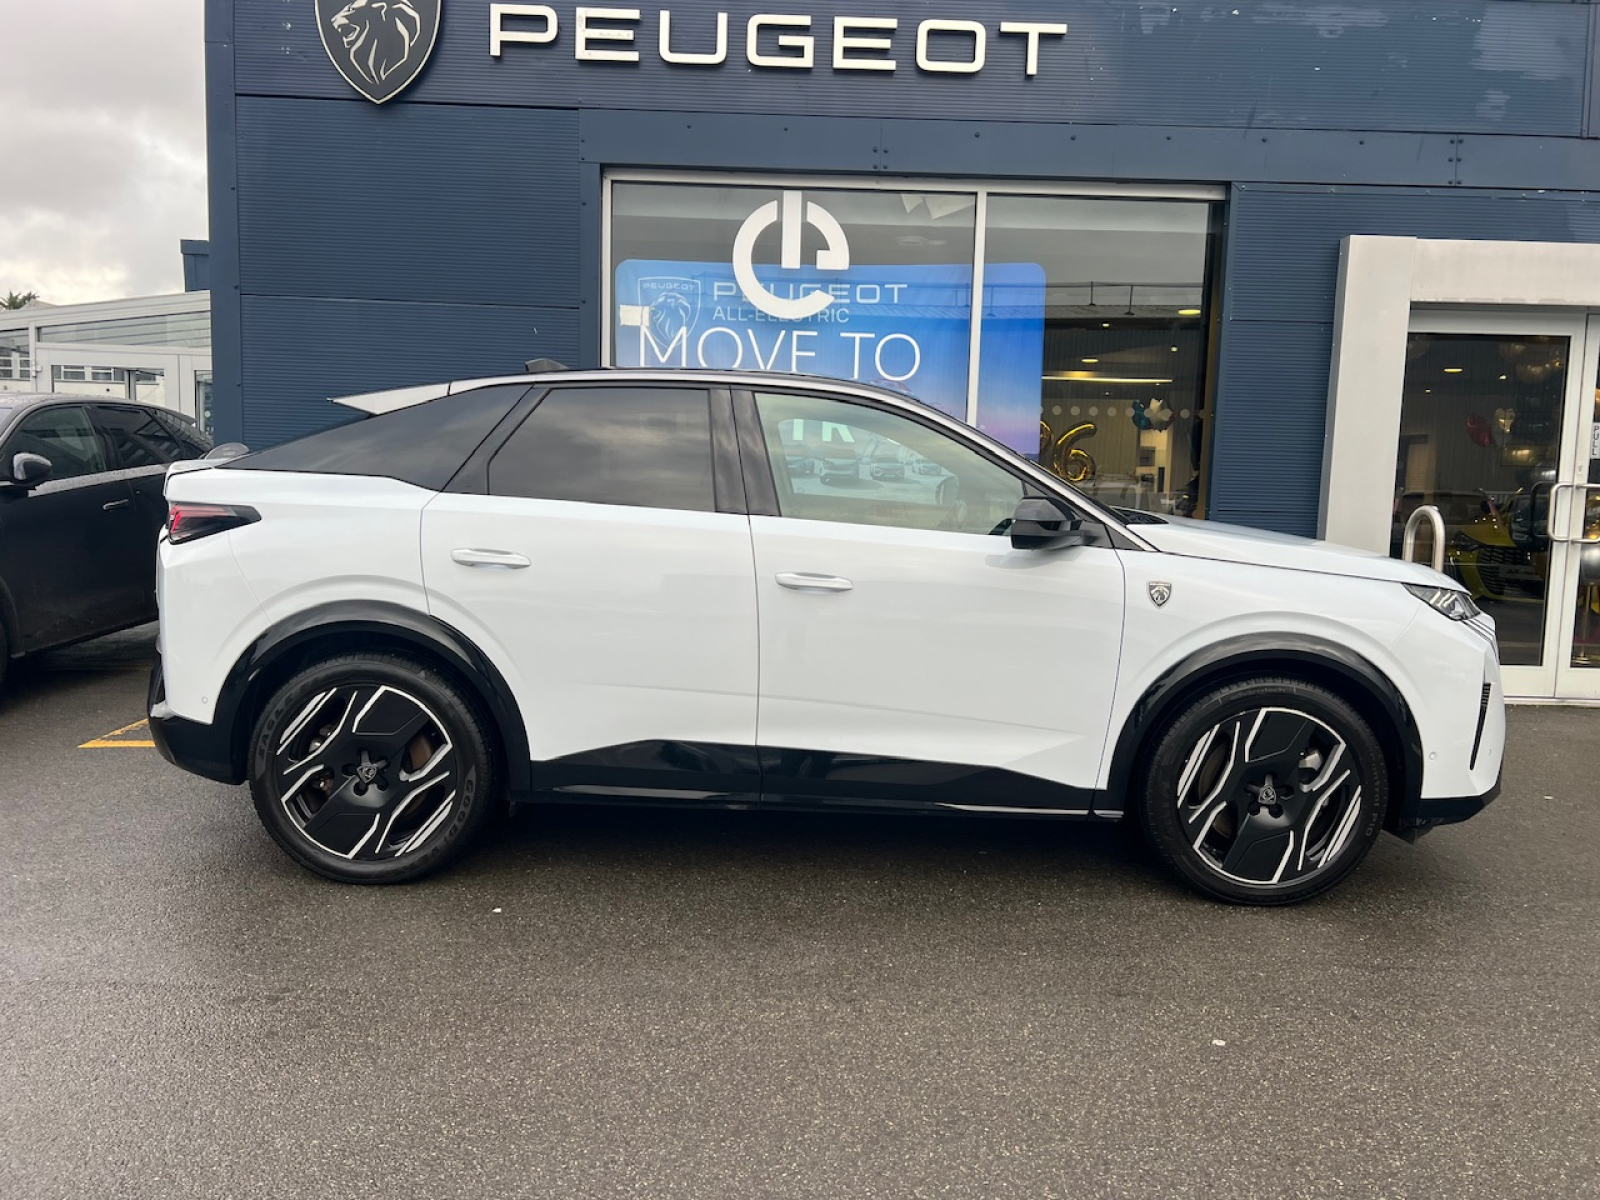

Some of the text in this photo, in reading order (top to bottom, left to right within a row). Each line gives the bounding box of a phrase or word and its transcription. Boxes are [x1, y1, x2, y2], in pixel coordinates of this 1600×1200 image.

[490, 3, 1067, 75] PEUGEOT
[643, 281, 695, 291] PEUGEOT
[714, 281, 908, 304] PUGEOT
[840, 333, 921, 381] TO
